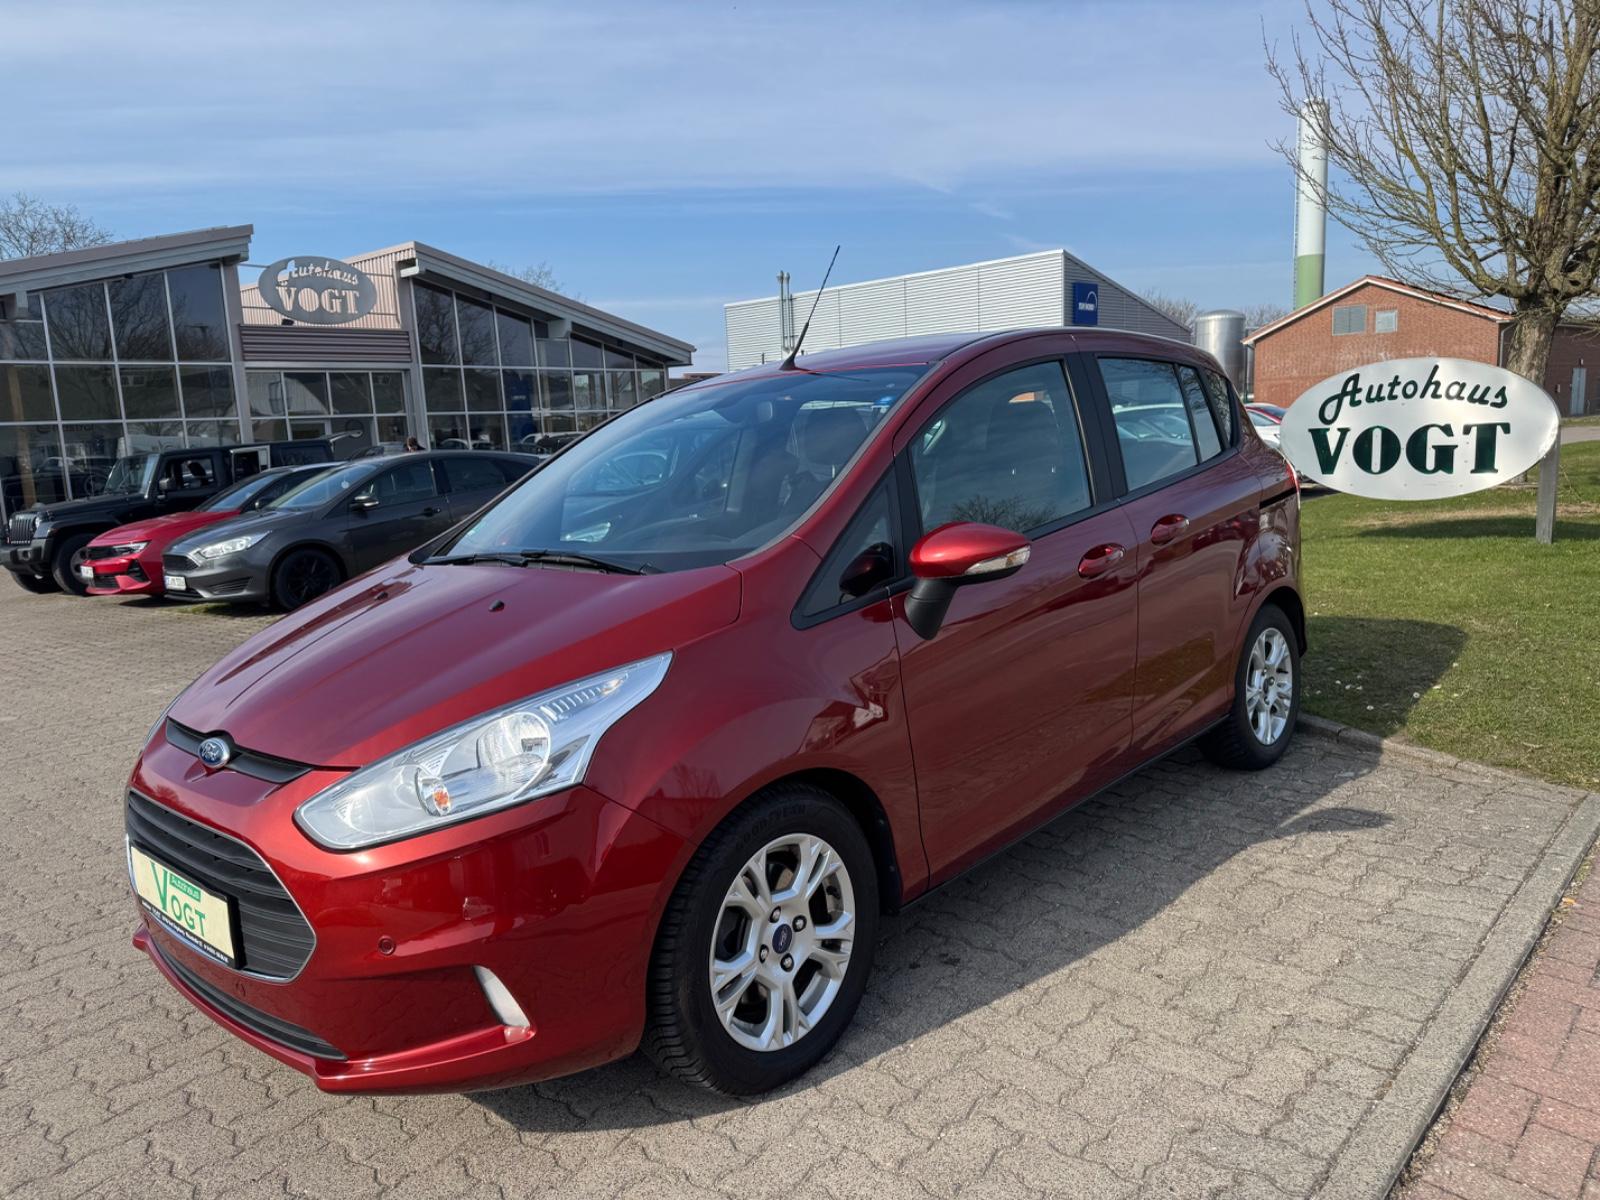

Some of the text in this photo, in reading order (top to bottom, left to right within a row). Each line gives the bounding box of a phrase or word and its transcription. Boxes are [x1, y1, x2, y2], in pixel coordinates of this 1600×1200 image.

[277, 260, 359, 286] Autohaus
[275, 286, 360, 314] VOGT
[1318, 364, 1508, 425] Autohaus
[1308, 422, 1511, 475] VOGT
